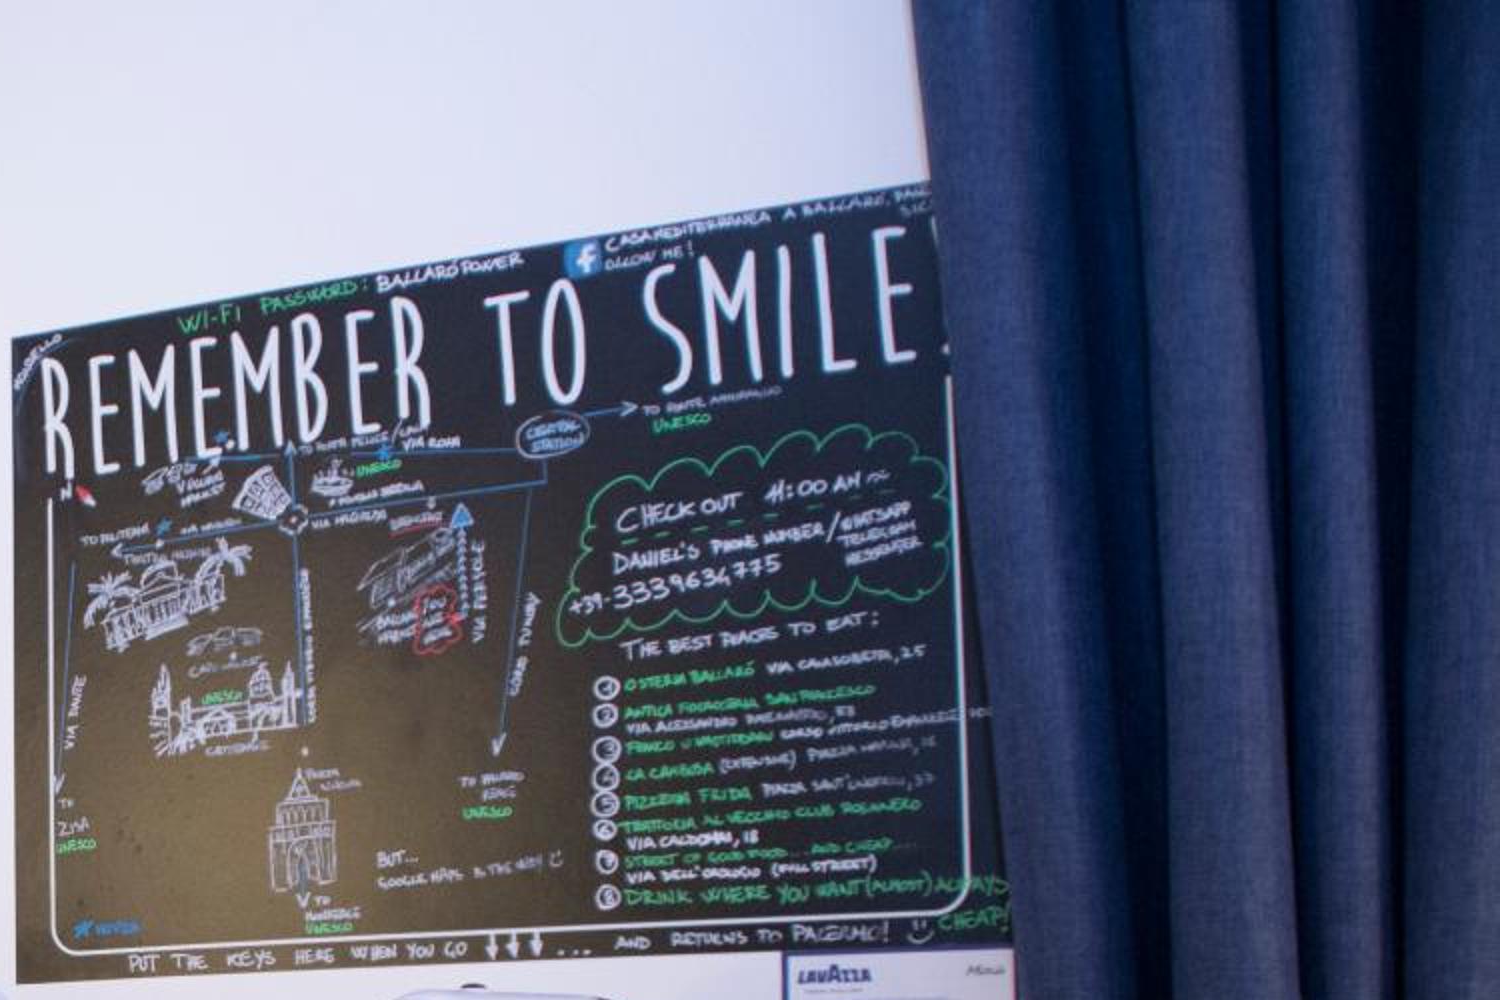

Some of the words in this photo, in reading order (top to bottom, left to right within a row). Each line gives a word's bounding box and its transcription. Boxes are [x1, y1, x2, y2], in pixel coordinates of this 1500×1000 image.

[178, 303, 241, 334] WI-FI
[40, 295, 432, 480] REMEMBER
[484, 278, 586, 406] TO
[652, 412, 712, 435] UNESCO
[615, 501, 697, 533] CHECK
[701, 491, 744, 516] OUT
[832, 472, 863, 494] AM
[613, 538, 701, 576] DANIEL'S
[619, 637, 663, 661] THE
[667, 633, 714, 654] BEST
[788, 619, 817, 637] TO
[766, 659, 794, 675] VIA
[626, 721, 653, 736] VIA
[462, 805, 513, 821] UNESCO
[795, 803, 836, 818] CLUB
[626, 835, 657, 851] VIA
[626, 869, 657, 884] VIA
[623, 887, 693, 905] DRINK
[701, 884, 772, 901] WHERE
[776, 883, 810, 905] YOU
[129, 953, 161, 973] PUT
[169, 952, 210, 971] THE
[227, 949, 276, 970] KEYS
[294, 948, 336, 965] HERE
[350, 942, 398, 962] WHEN
[406, 942, 435, 958] YOU
[443, 941, 468, 956] GO
[613, 935, 651, 951] AND
[756, 928, 783, 943] TO
[797, 963, 873, 985] LAVAZZA
